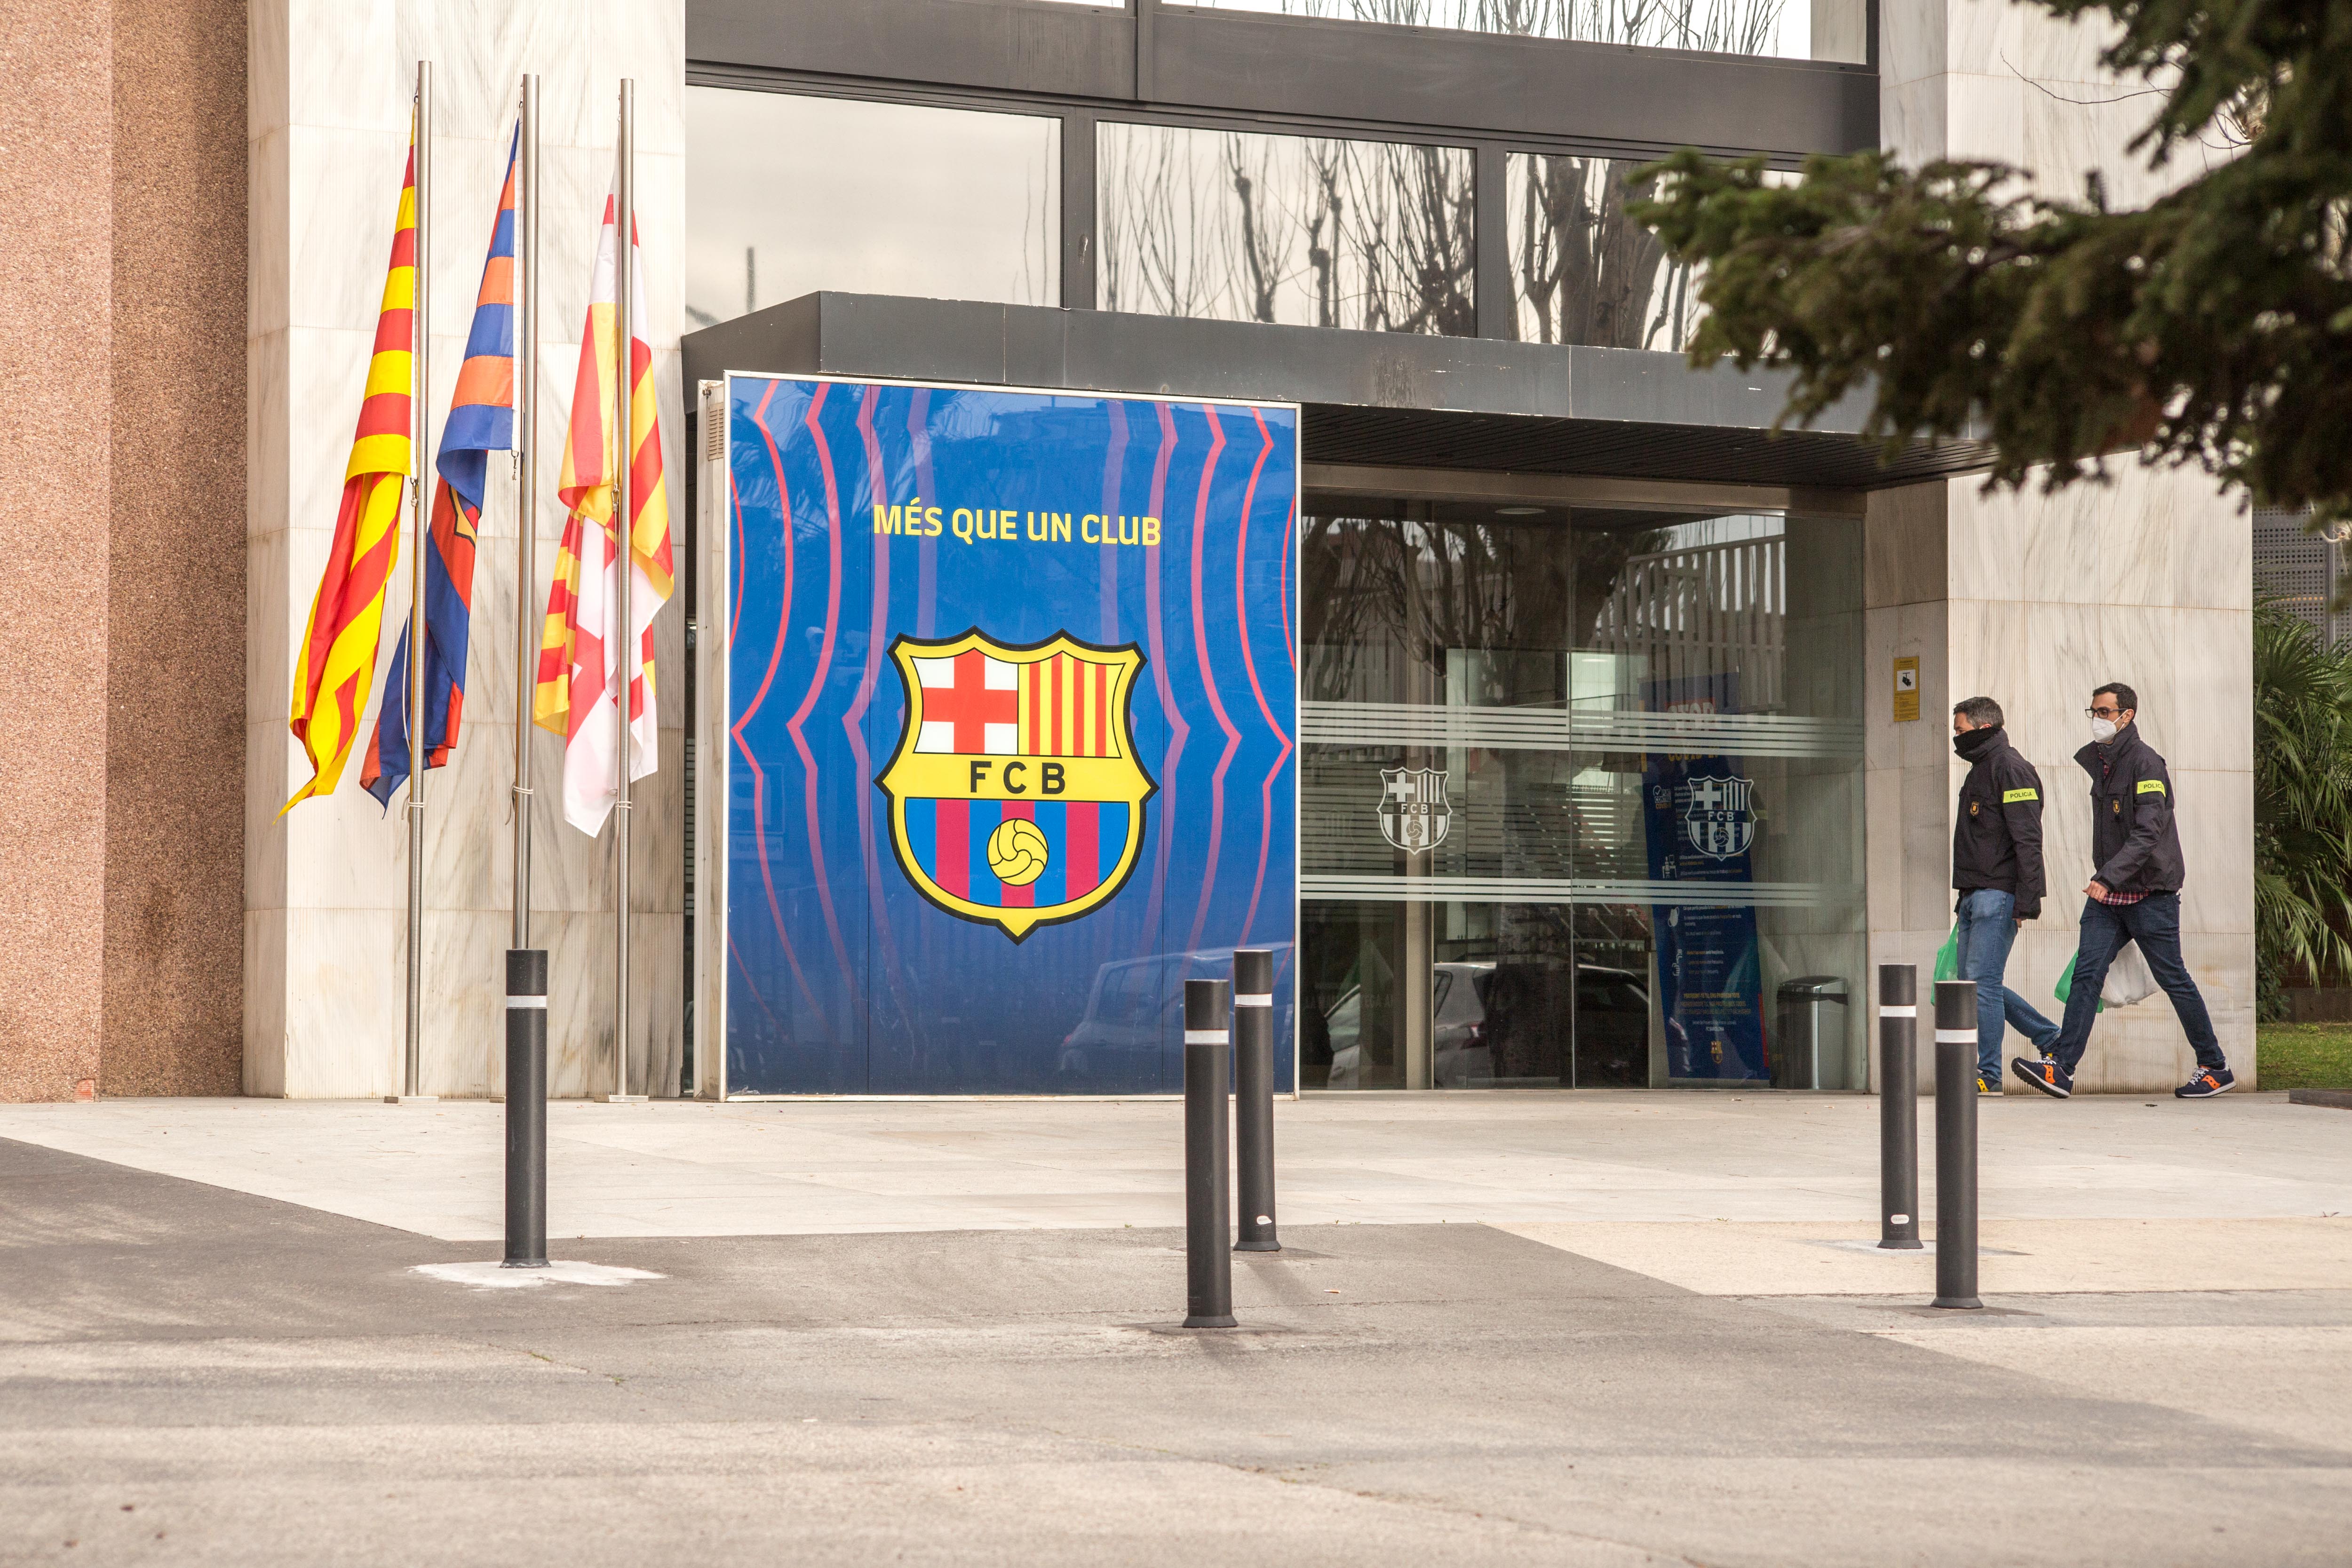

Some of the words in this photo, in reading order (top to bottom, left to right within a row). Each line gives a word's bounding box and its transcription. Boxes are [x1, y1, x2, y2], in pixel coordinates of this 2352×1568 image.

[874, 497, 942, 536] MÉS
[952, 508, 1017, 544] QUE
[1027, 512, 1072, 542] UN
[1081, 514, 1161, 546] CLUB
[970, 761, 1065, 794] FCB
[1401, 804, 1428, 814] FCB
[1708, 811, 1734, 821] FCB
